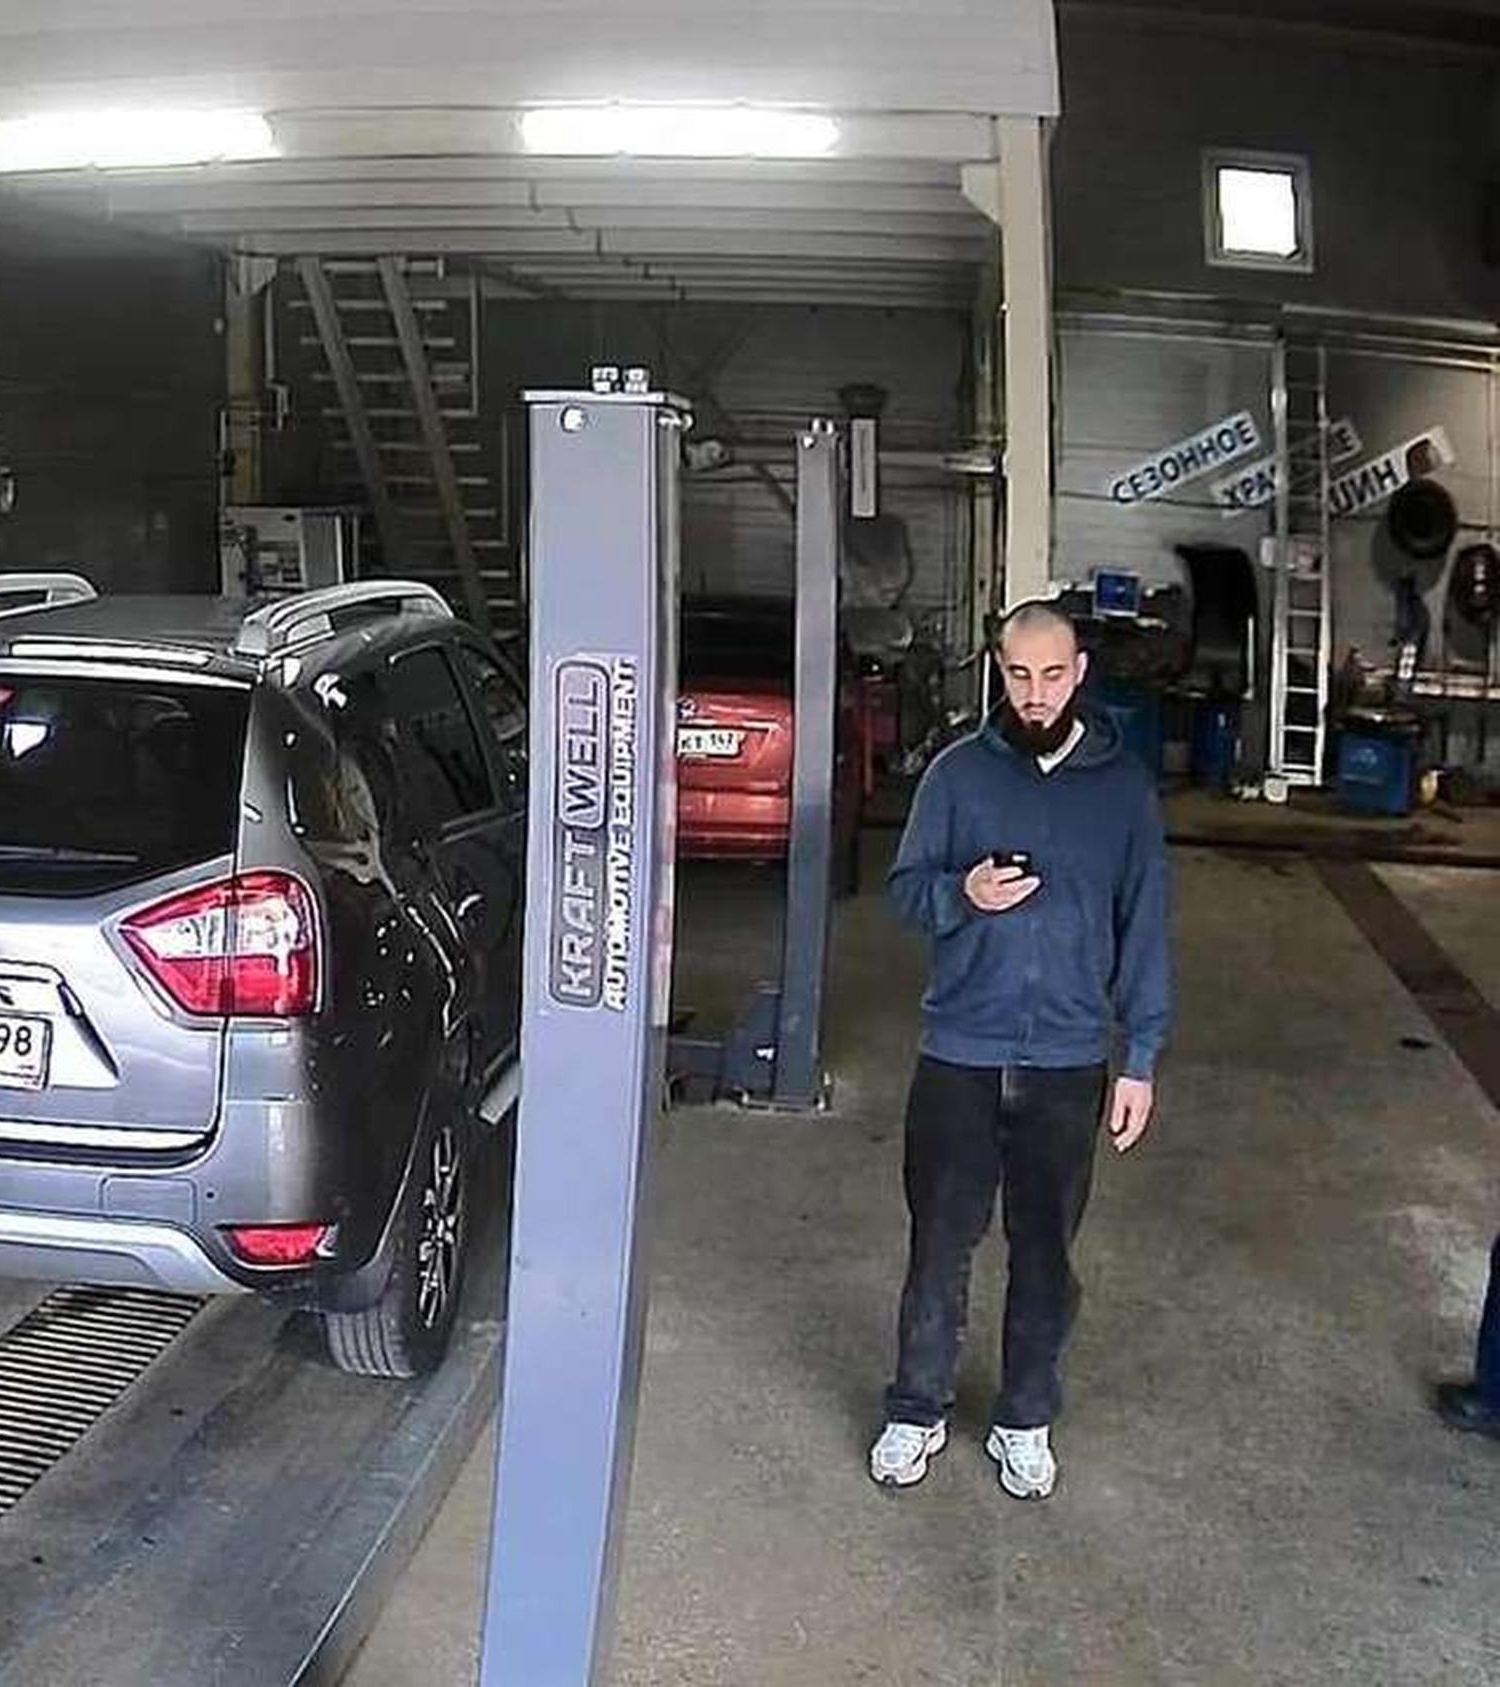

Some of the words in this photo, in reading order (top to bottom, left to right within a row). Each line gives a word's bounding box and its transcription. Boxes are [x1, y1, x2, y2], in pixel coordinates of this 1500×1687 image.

[1113, 419, 1255, 503] СЕЗОННОЕ
[610, 657, 638, 827] EQUIPMENT
[604, 830, 635, 1011] AUTOMOTIVE
